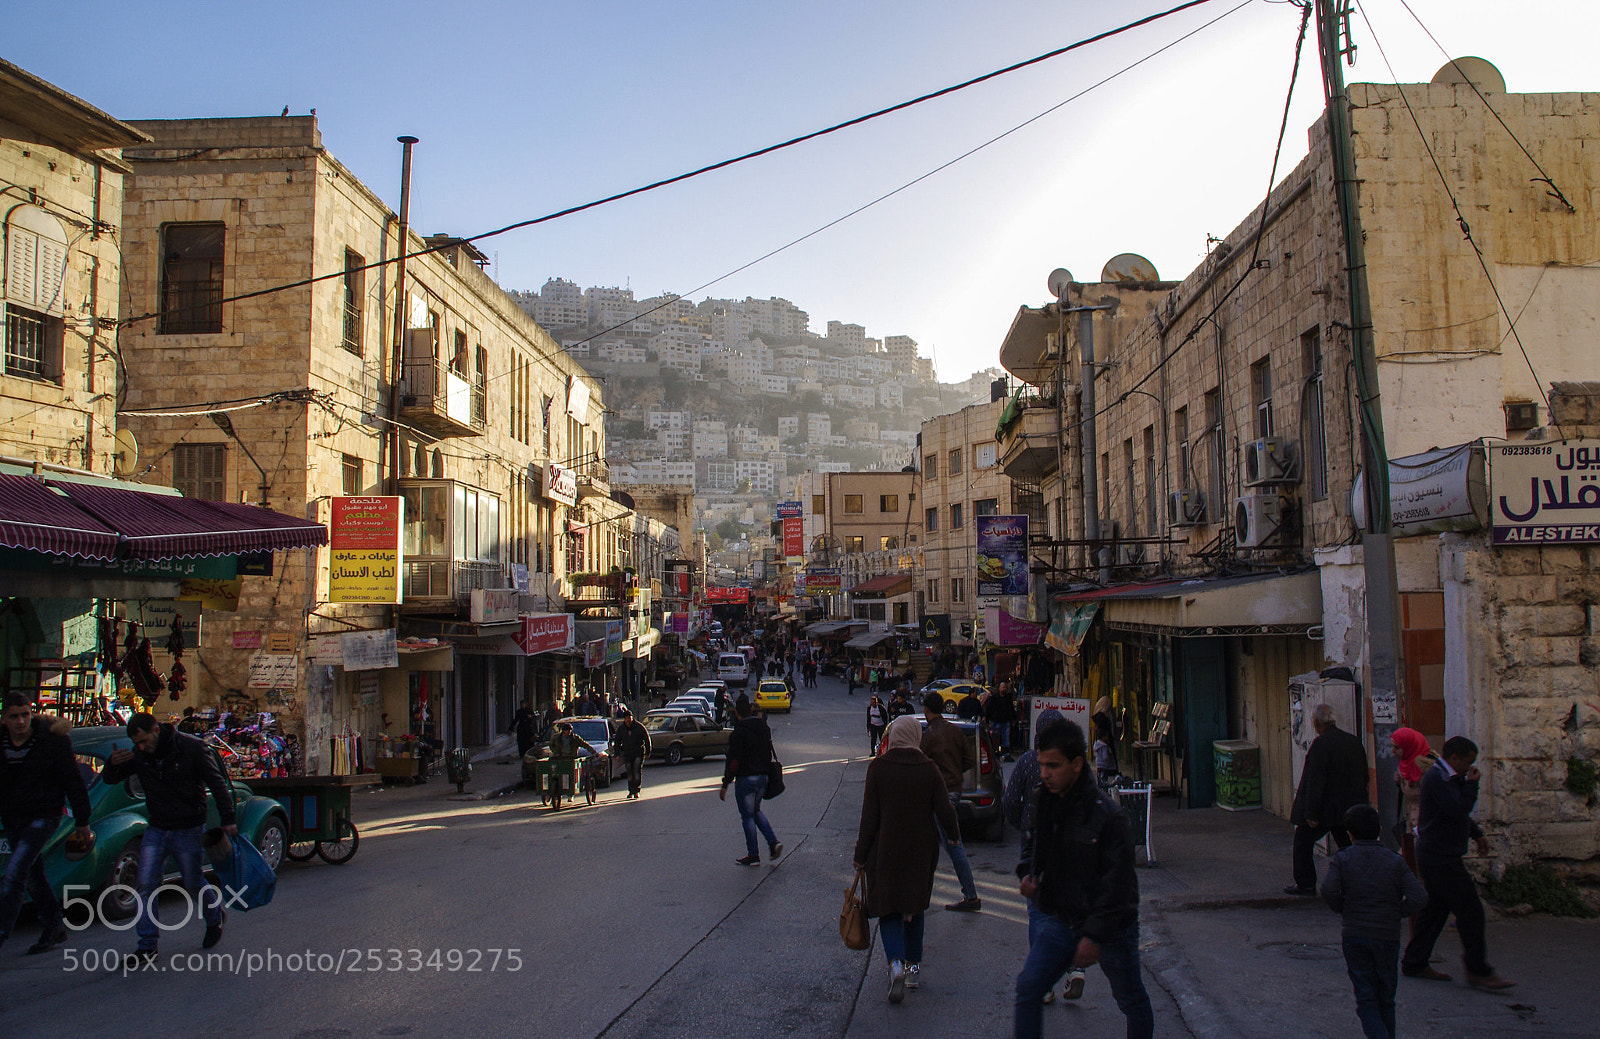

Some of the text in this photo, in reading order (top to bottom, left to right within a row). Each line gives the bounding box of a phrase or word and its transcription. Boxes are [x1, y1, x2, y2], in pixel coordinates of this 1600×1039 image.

[1502, 447, 1552, 456] 092383618
[1407, 484, 1442, 503] بنسيون
[345, 510, 381, 520] مطعم
[1504, 526, 1600, 541] ALESTEK
[335, 552, 358, 561] عارف
[368, 552, 396, 561] عيادات
[183, 562, 195, 574] كل
[332, 566, 395, 580] لطب الاسنان
[1060, 701, 1086, 714] مواقف
